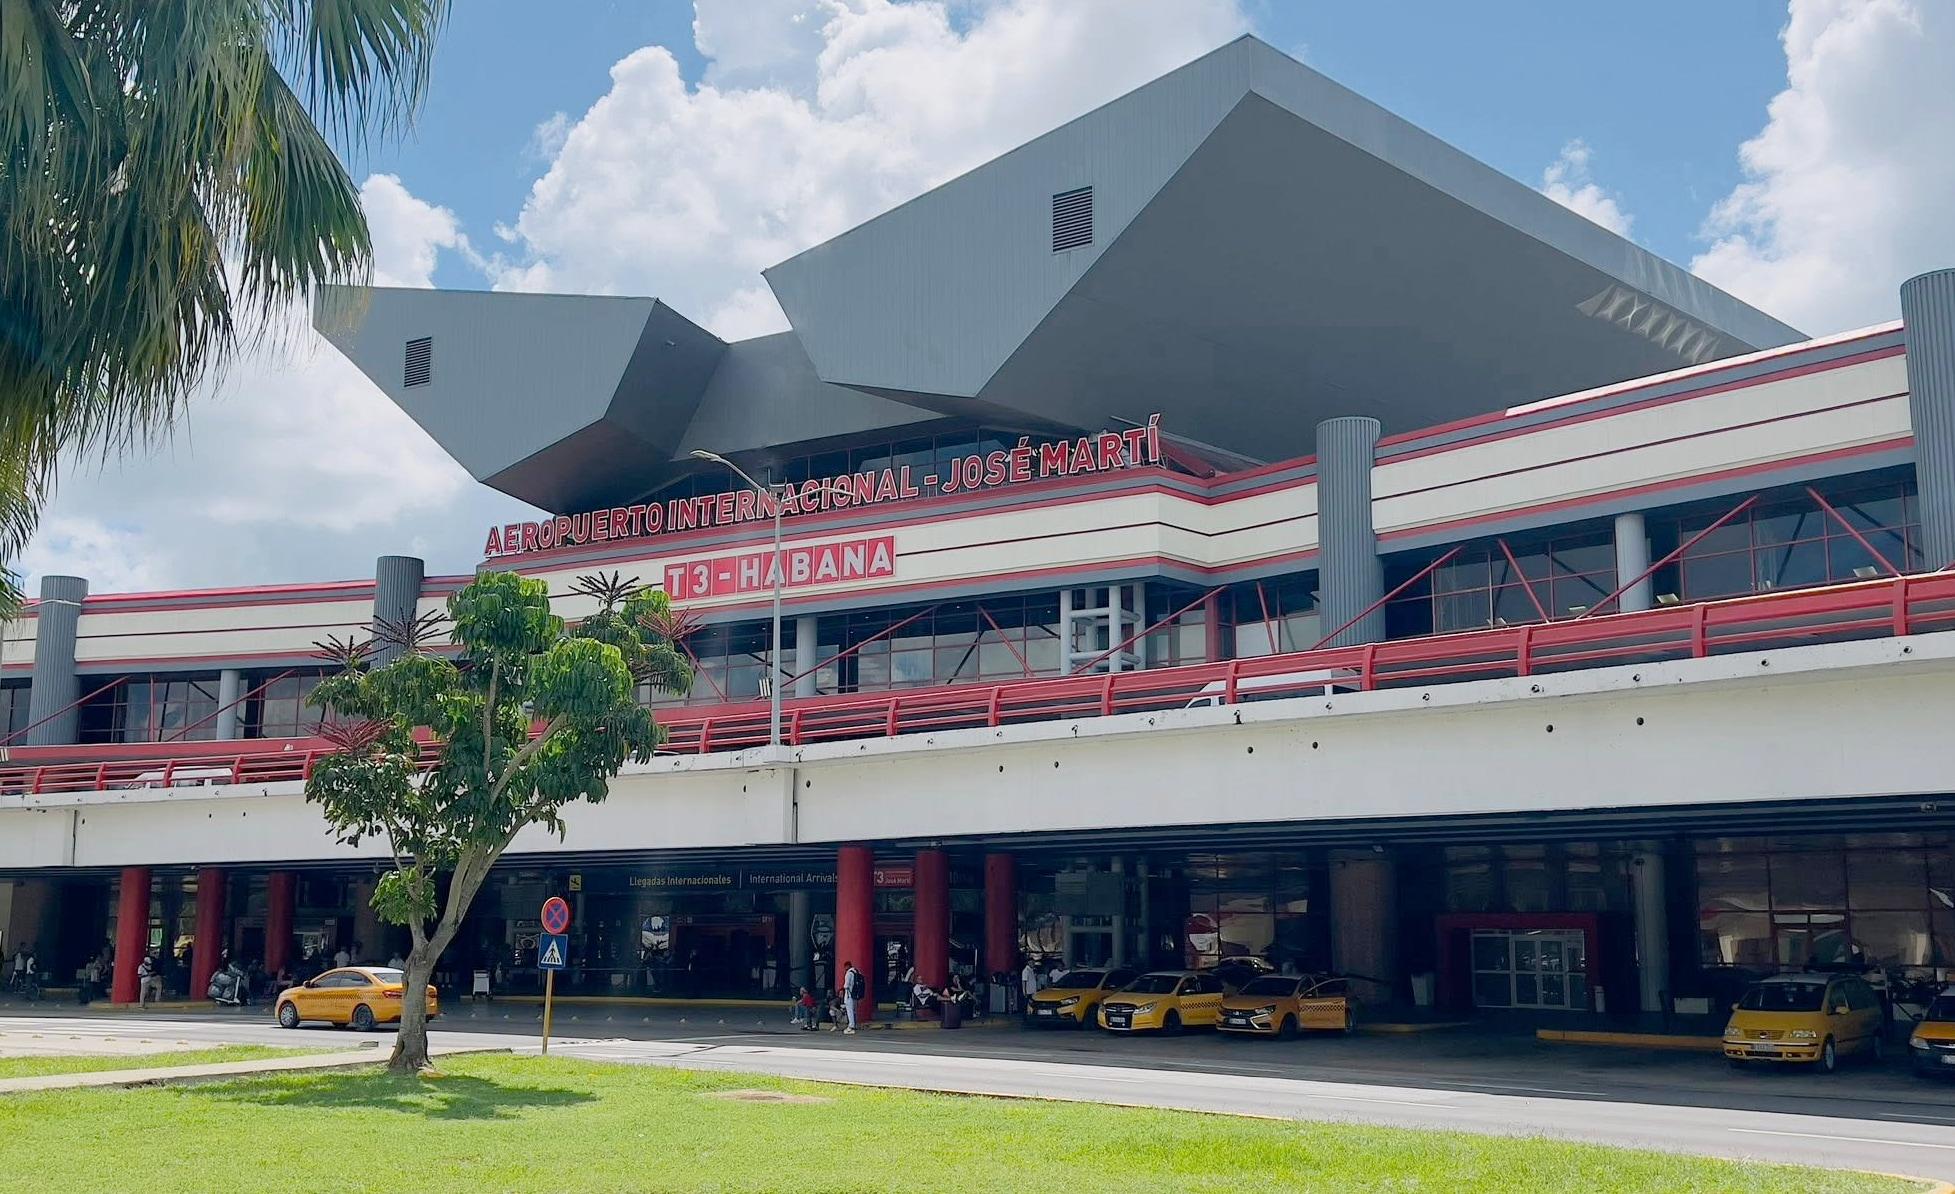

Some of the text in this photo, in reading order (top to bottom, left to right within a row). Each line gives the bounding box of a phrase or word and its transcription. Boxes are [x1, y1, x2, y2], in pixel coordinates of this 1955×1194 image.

[484, 502, 666, 557] AEROPUERTO
[668, 465, 918, 530] INTERNACIONAL
[942, 436, 1032, 493] JOSÉ
[1039, 413, 1161, 478] MARTÍ
[629, 874, 732, 887] Llegadas Internacionales
[750, 873, 804, 884] International
